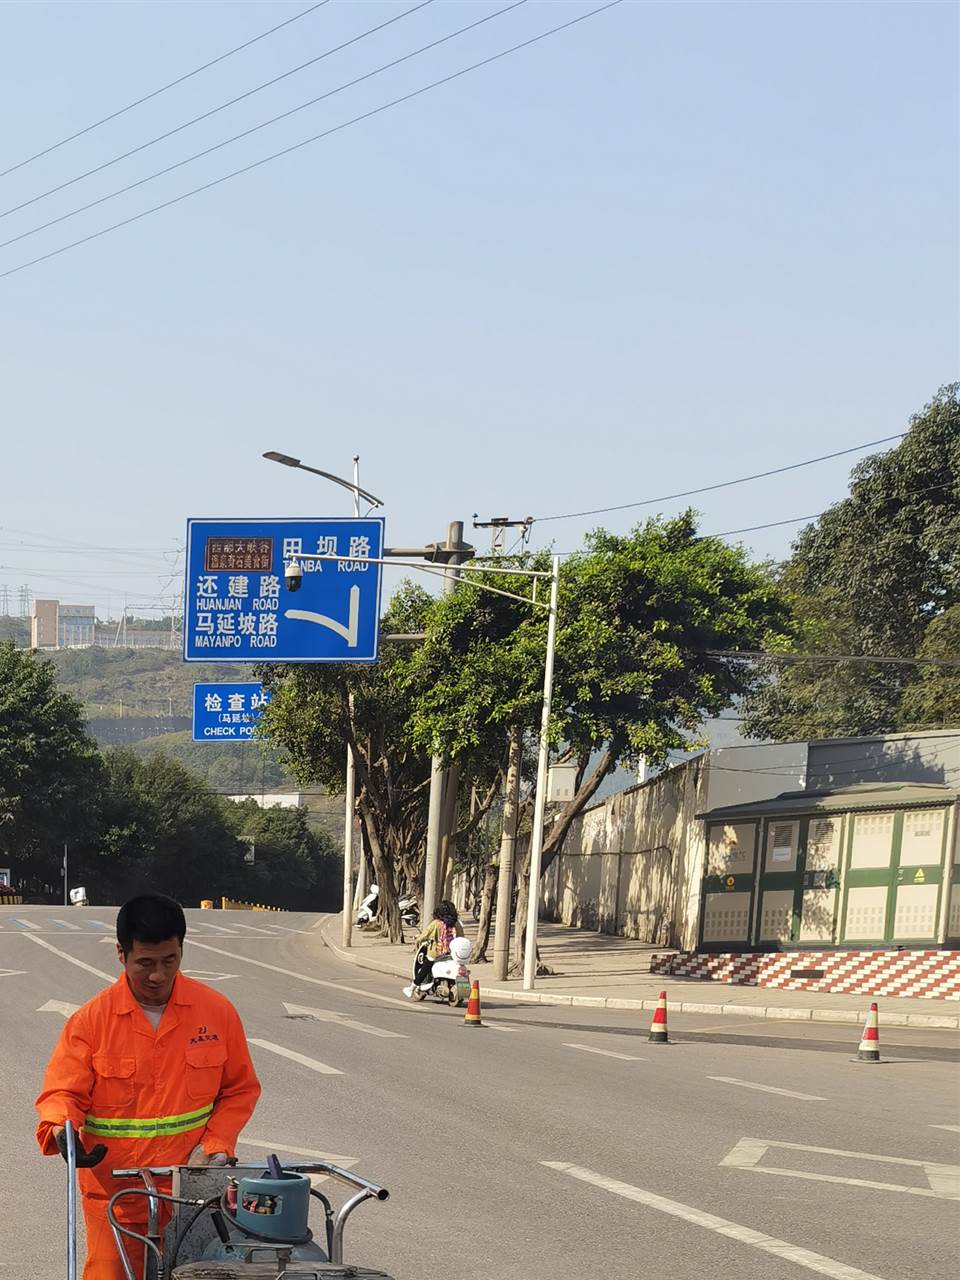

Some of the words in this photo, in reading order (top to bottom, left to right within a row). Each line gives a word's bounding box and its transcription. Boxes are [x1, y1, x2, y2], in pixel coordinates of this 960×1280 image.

[283, 535, 372, 560] 田坝路
[337, 560, 369, 573] ROAD
[196, 575, 281, 598] 还建路
[196, 598, 242, 610] HUANJIAN
[252, 598, 279, 610] ROAD
[195, 612, 279, 635] 马延坡路
[194, 635, 242, 647] MAYANPO
[250, 635, 278, 647] ROAD
[203, 726, 236, 736] CHECK
